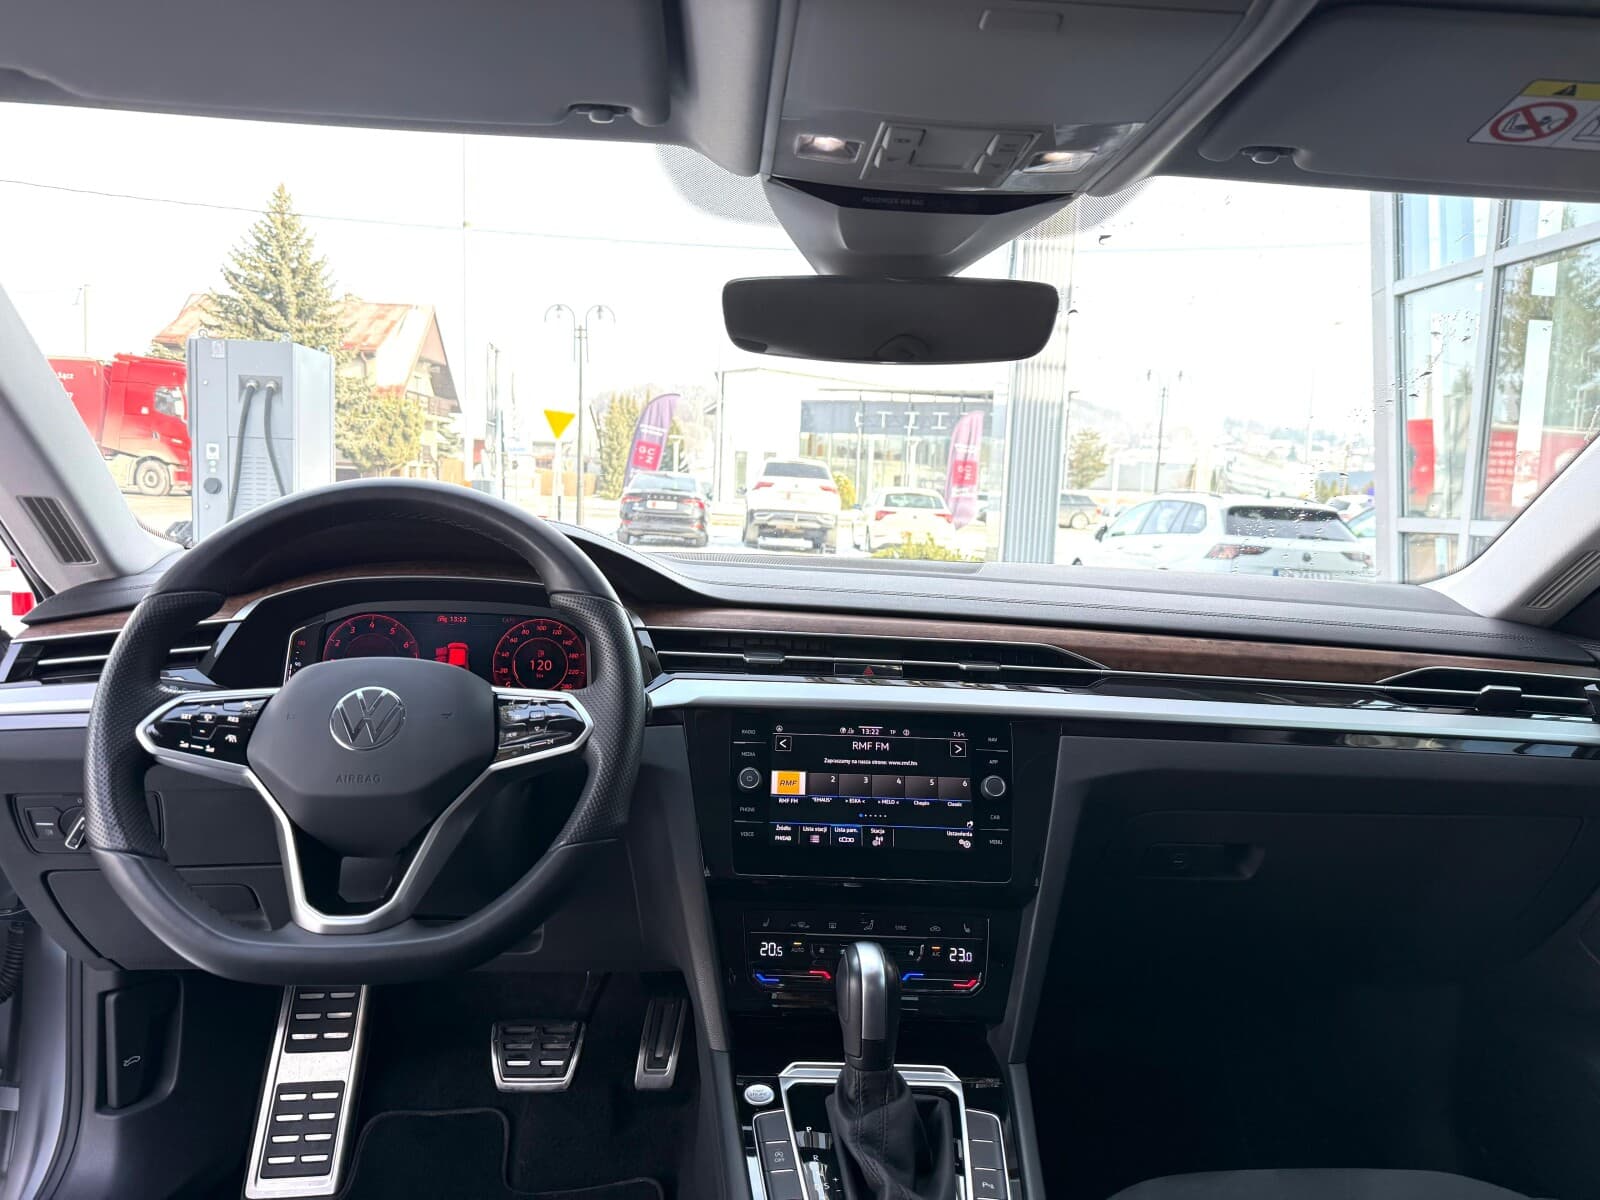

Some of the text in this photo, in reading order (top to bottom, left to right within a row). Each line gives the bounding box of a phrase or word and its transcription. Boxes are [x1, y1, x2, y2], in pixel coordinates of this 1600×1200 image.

[350, 626, 356, 634] 3
[390, 627, 396, 635] 5
[334, 639, 341, 647] 2
[403, 641, 409, 649] 6
[530, 659, 552, 671] 120
[852, 741, 889, 751] RMF FM
[335, 774, 383, 785] AIRBAG
[779, 779, 798, 787] RMF
[830, 775, 836, 783] 2
[863, 776, 869, 784] 3
[896, 777, 902, 785] 4
[929, 778, 935, 786] 5
[759, 942, 783, 957] 20.5
[949, 947, 973, 962] 23.0
[823, 1182, 831, 1190] S
